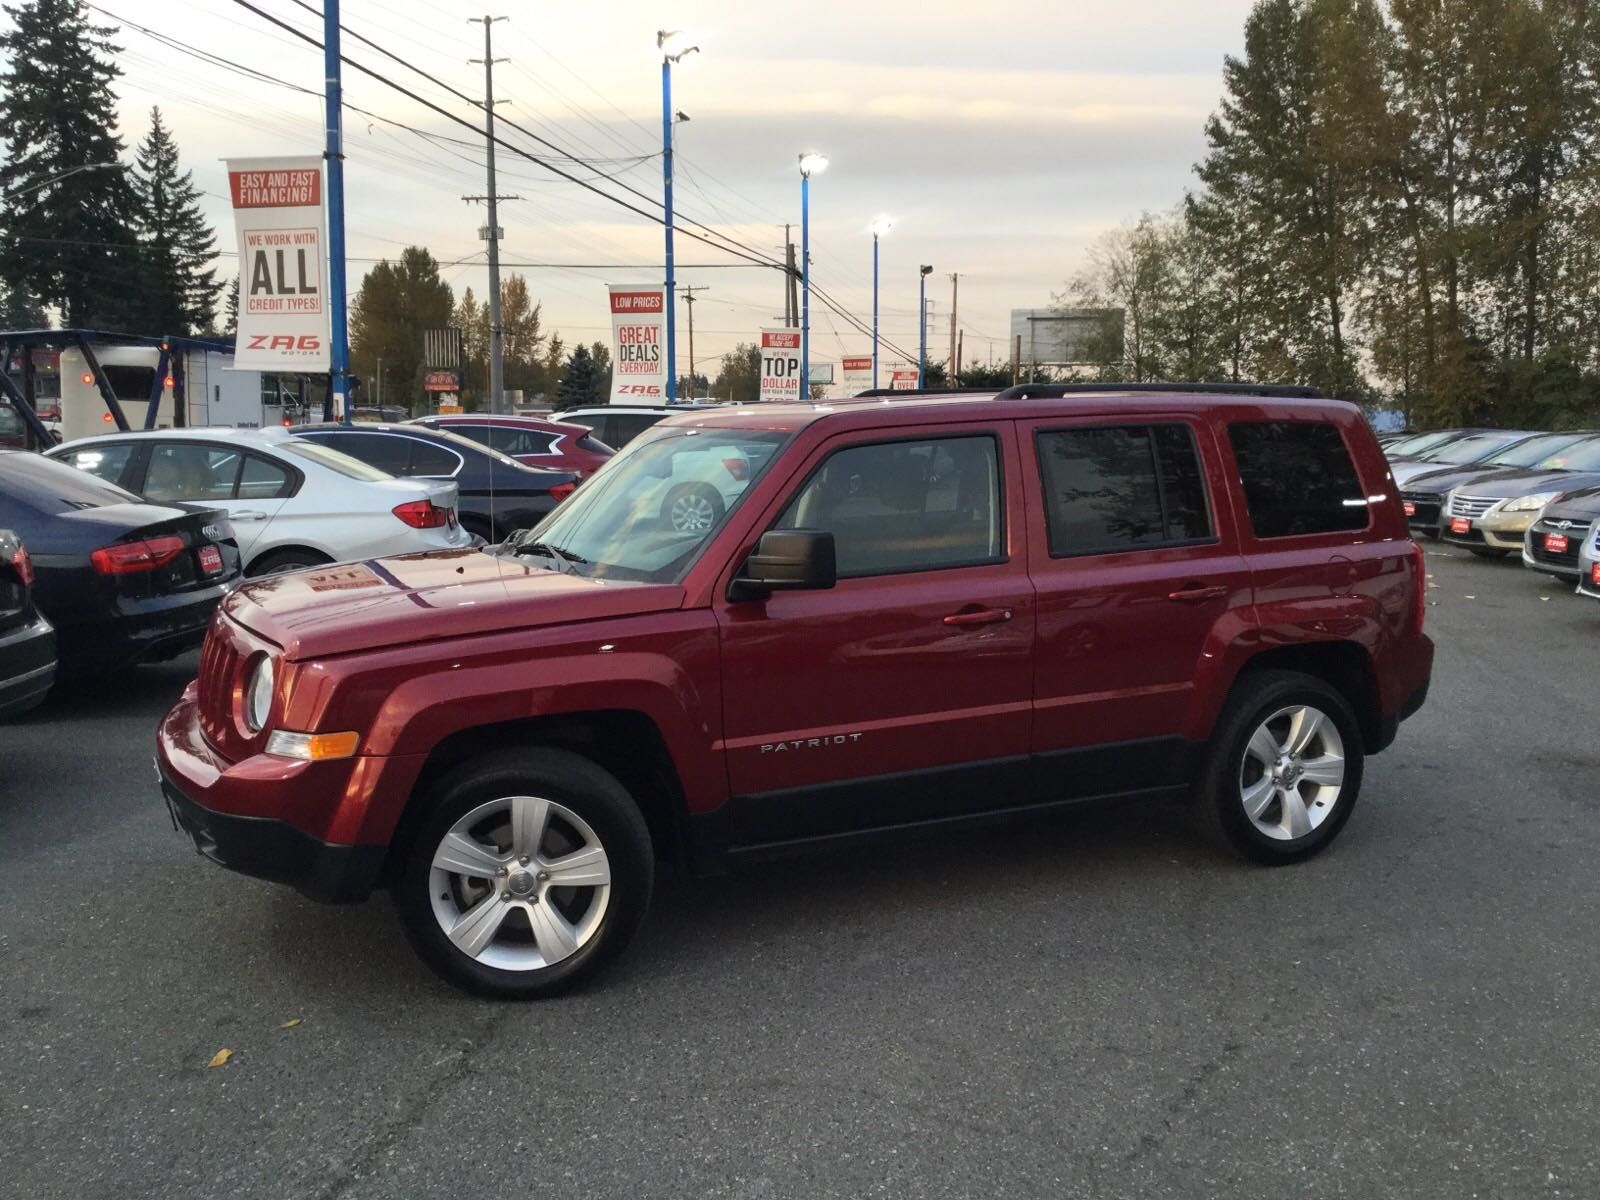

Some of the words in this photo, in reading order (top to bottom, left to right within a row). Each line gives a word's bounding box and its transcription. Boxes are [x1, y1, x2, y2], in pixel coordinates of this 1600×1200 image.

[240, 173, 265, 189] EASY
[267, 172, 288, 187] AND
[290, 171, 315, 187] FAST
[240, 187, 313, 204] FINANCING!
[248, 234, 262, 246] WE
[265, 233, 291, 246] WORK
[294, 233, 316, 245] WITH
[250, 249, 317, 295] ALL
[249, 299, 283, 310] CREDIT
[287, 298, 319, 310] TYPES!
[615, 297, 632, 308] LOW
[633, 296, 660, 308] PRICES
[246, 335, 320, 350] ZAG
[619, 326, 659, 344] GREAT
[620, 344, 659, 362] DEALS
[620, 362, 659, 373] EVERYDAY
[764, 357, 799, 377] TOP
[617, 385, 661, 394] ZAG
[762, 378, 797, 389] DOLLAR
[760, 733, 863, 753] PATRIOT
